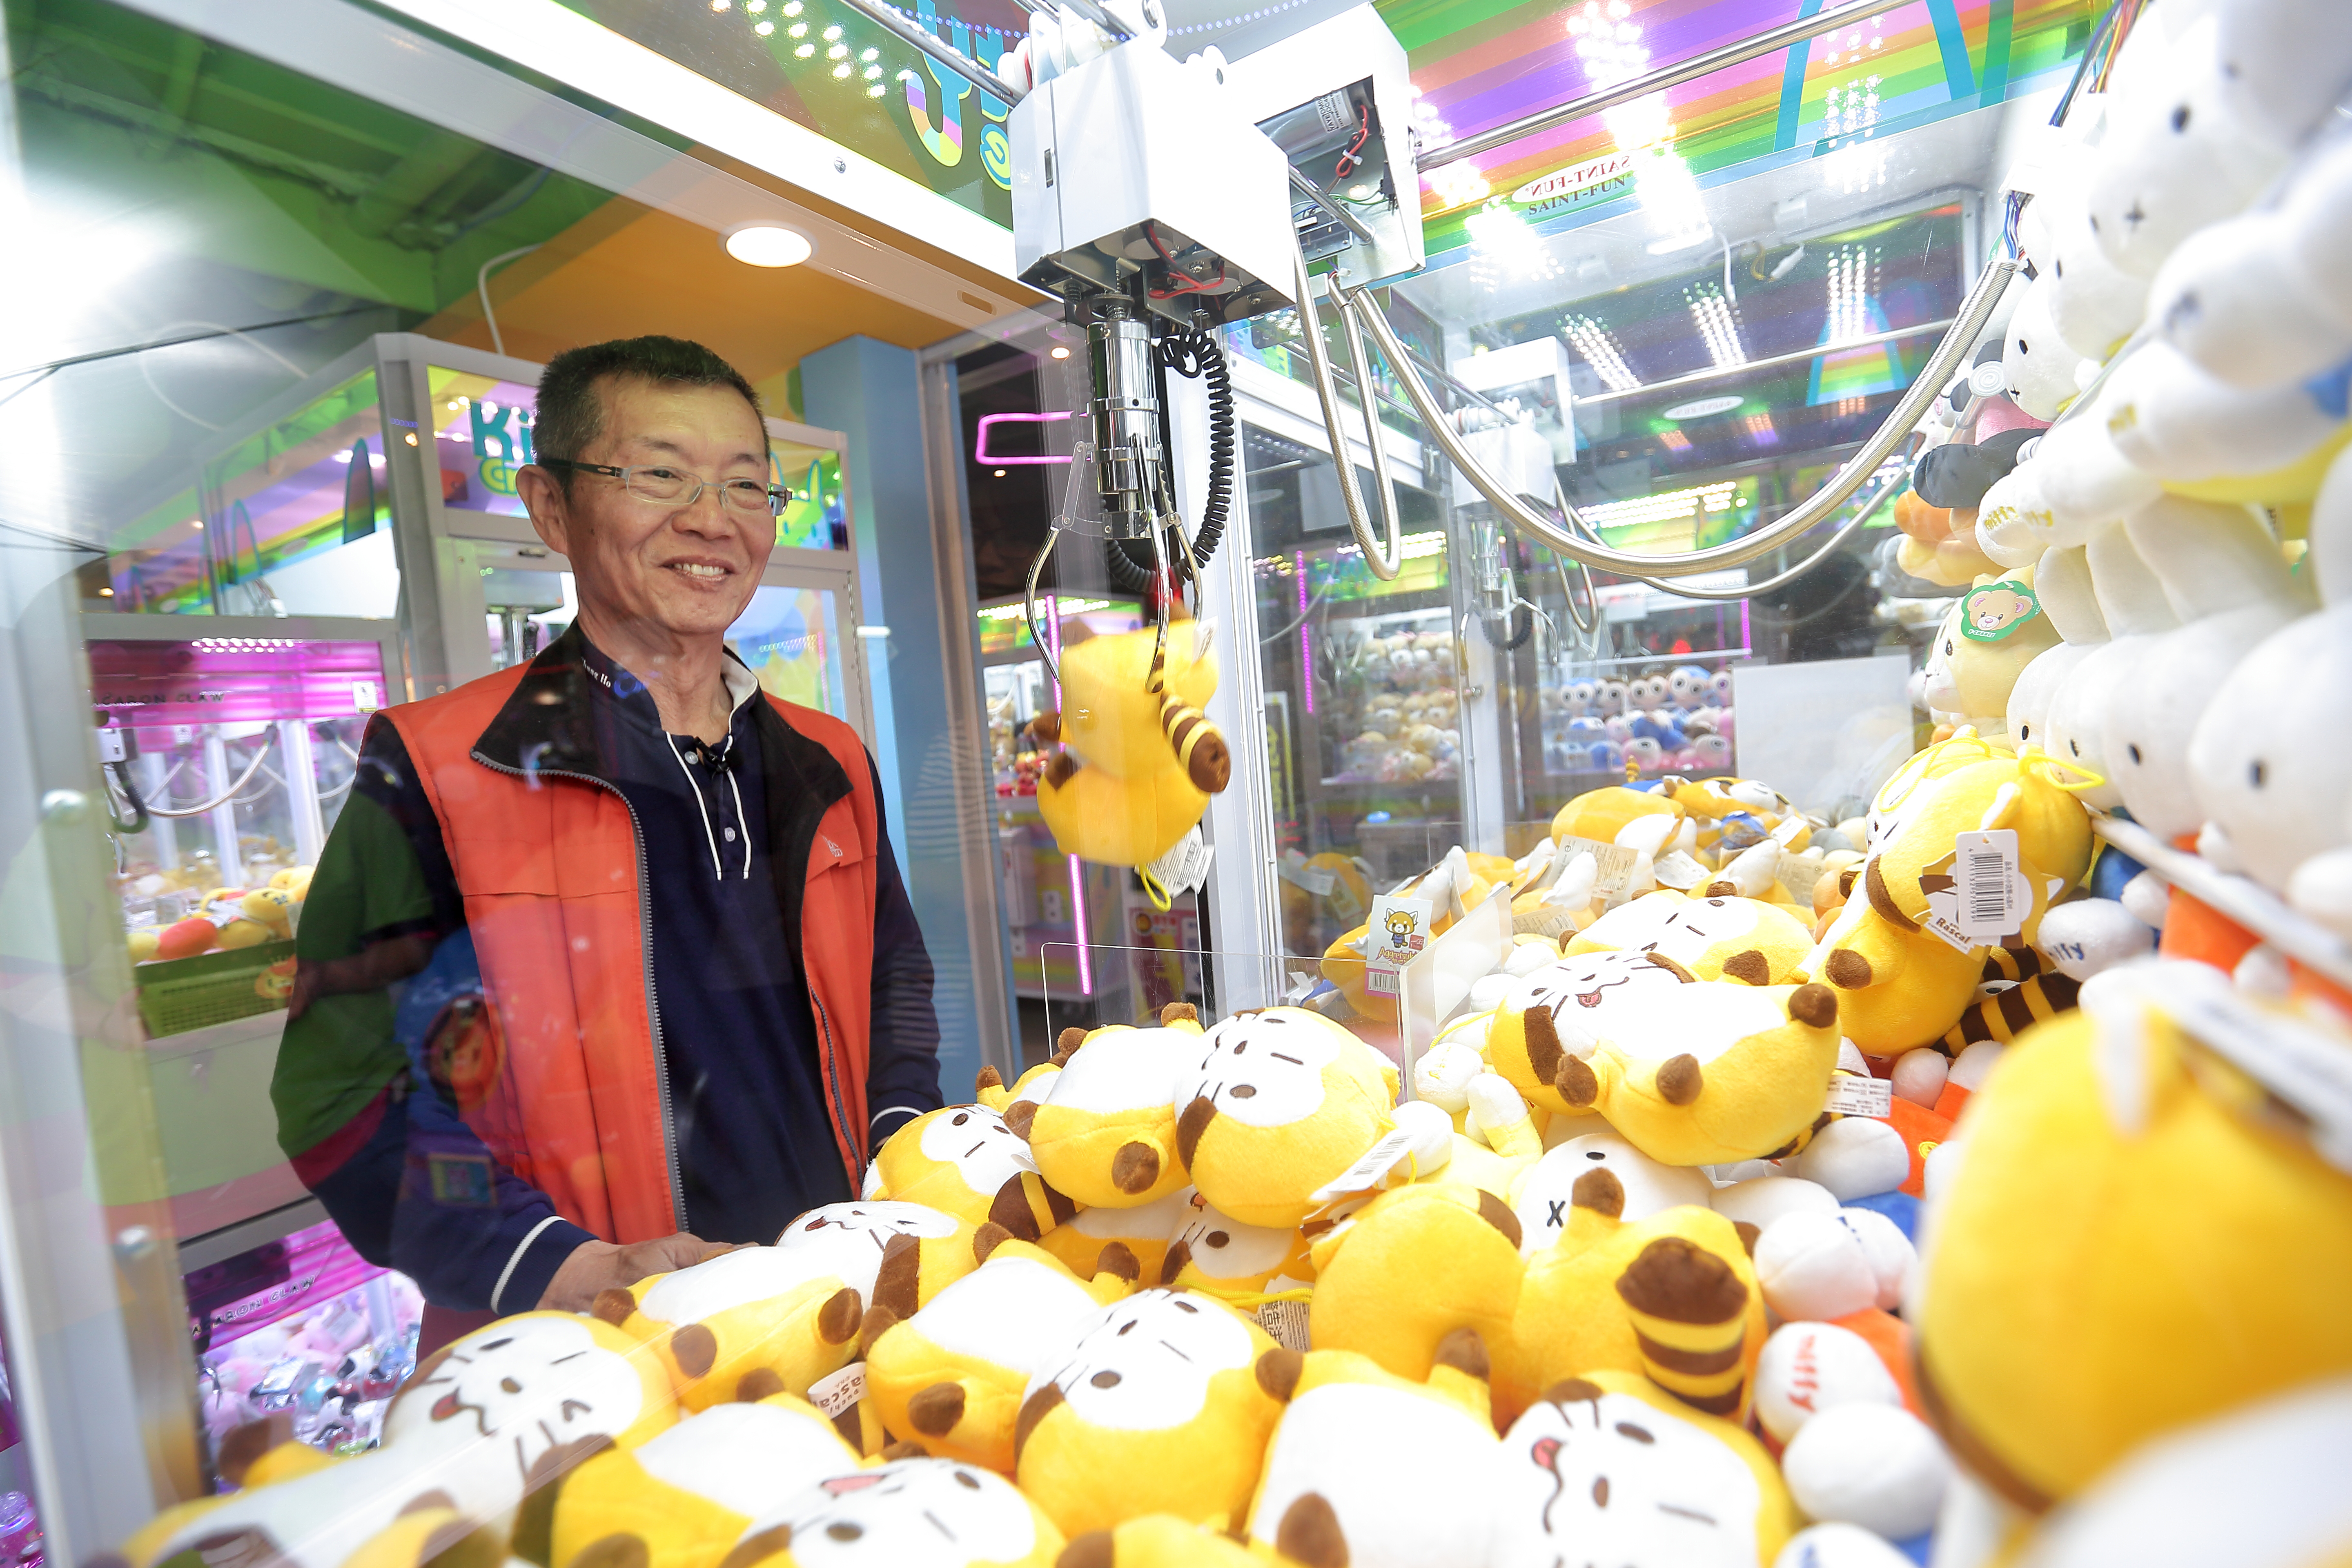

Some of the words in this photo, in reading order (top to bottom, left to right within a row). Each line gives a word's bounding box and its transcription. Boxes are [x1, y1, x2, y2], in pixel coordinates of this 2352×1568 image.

[600, 673, 611, 688] Ho
[177, 692, 224, 704] CLAW
[1936, 917, 1971, 944] Rascal
[269, 1276, 316, 1303] CLAW
[1265, 1301, 1285, 1349] 警告注
[818, 1374, 866, 1409] asca
